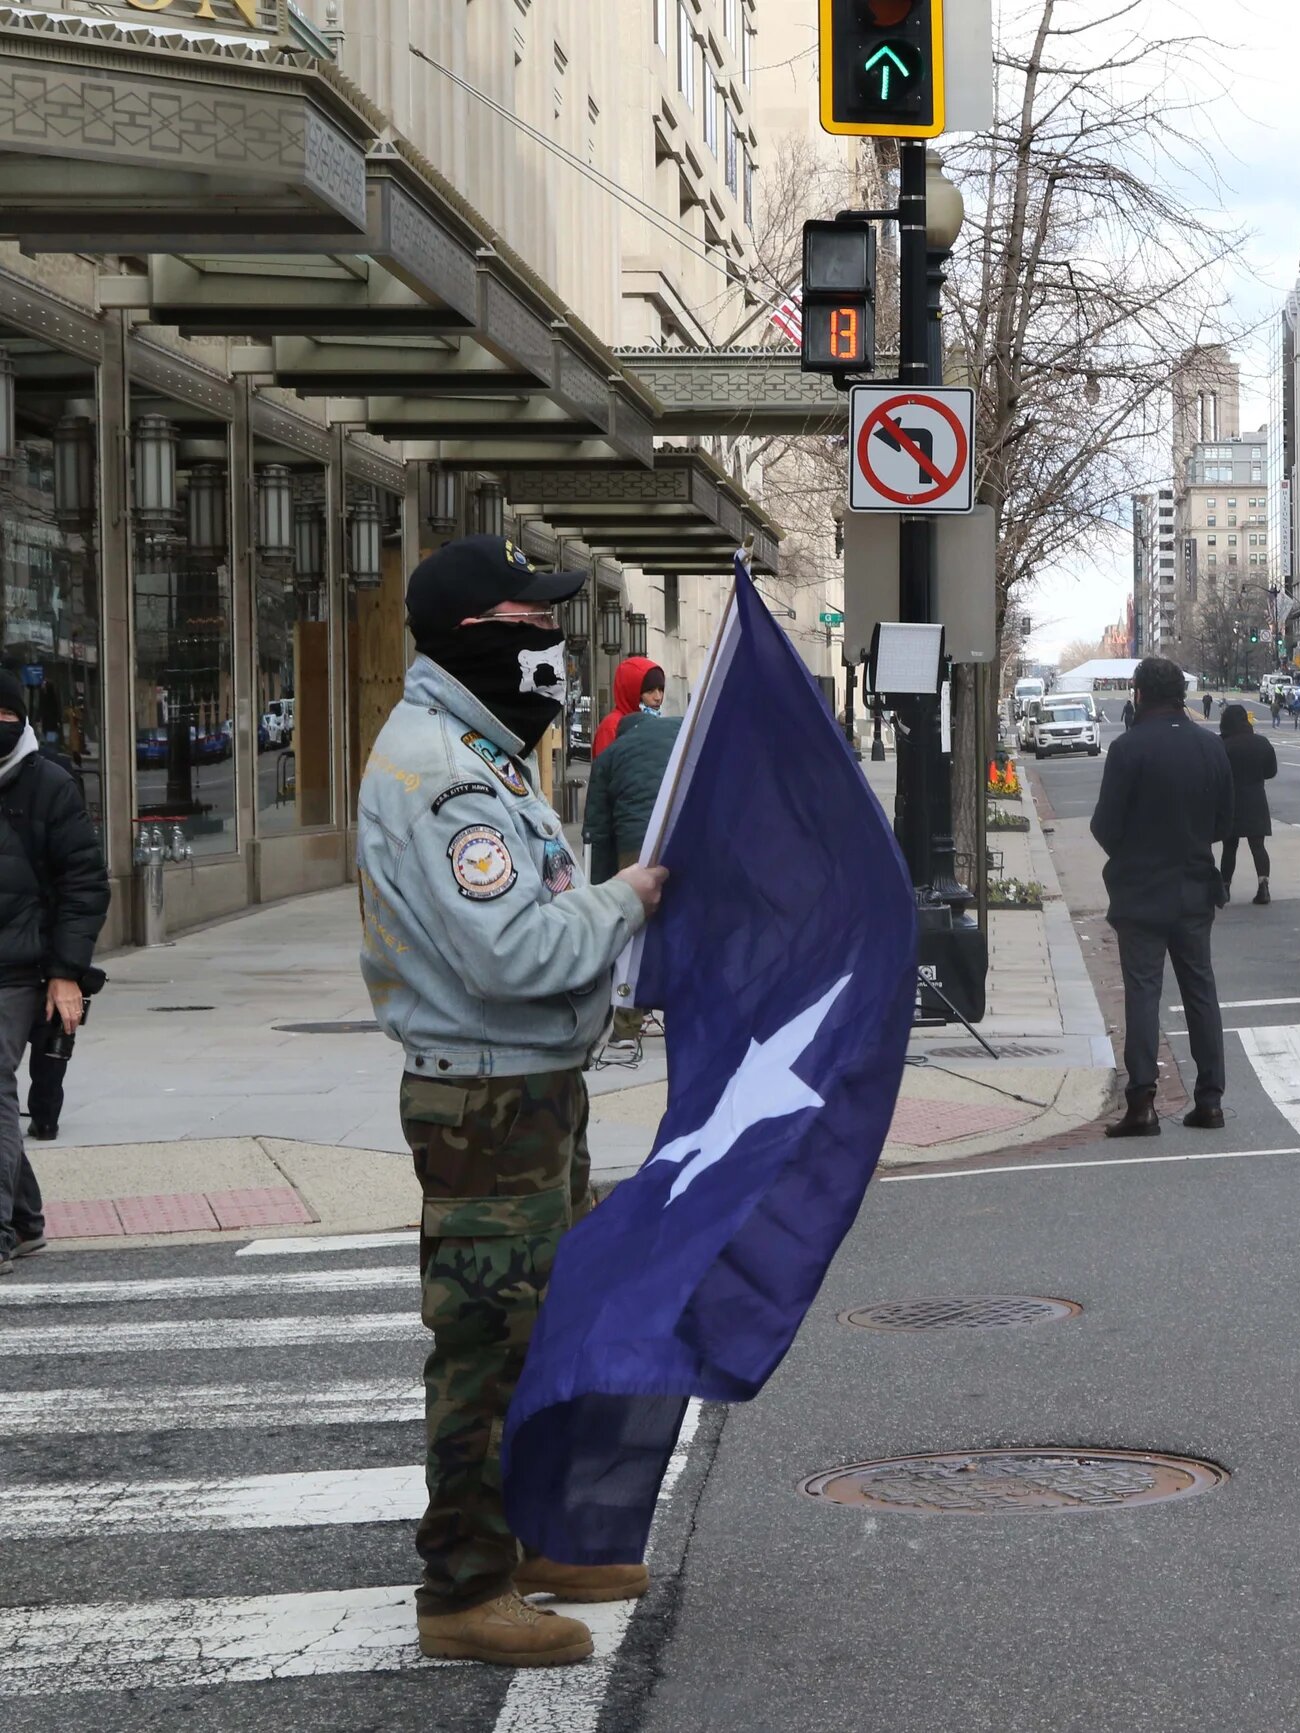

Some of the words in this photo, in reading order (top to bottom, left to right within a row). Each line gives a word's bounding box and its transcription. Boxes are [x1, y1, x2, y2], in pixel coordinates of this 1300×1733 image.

[830, 308, 857, 359] 13
[450, 784, 469, 795] KITTY
[471, 784, 490, 792] HAWK
